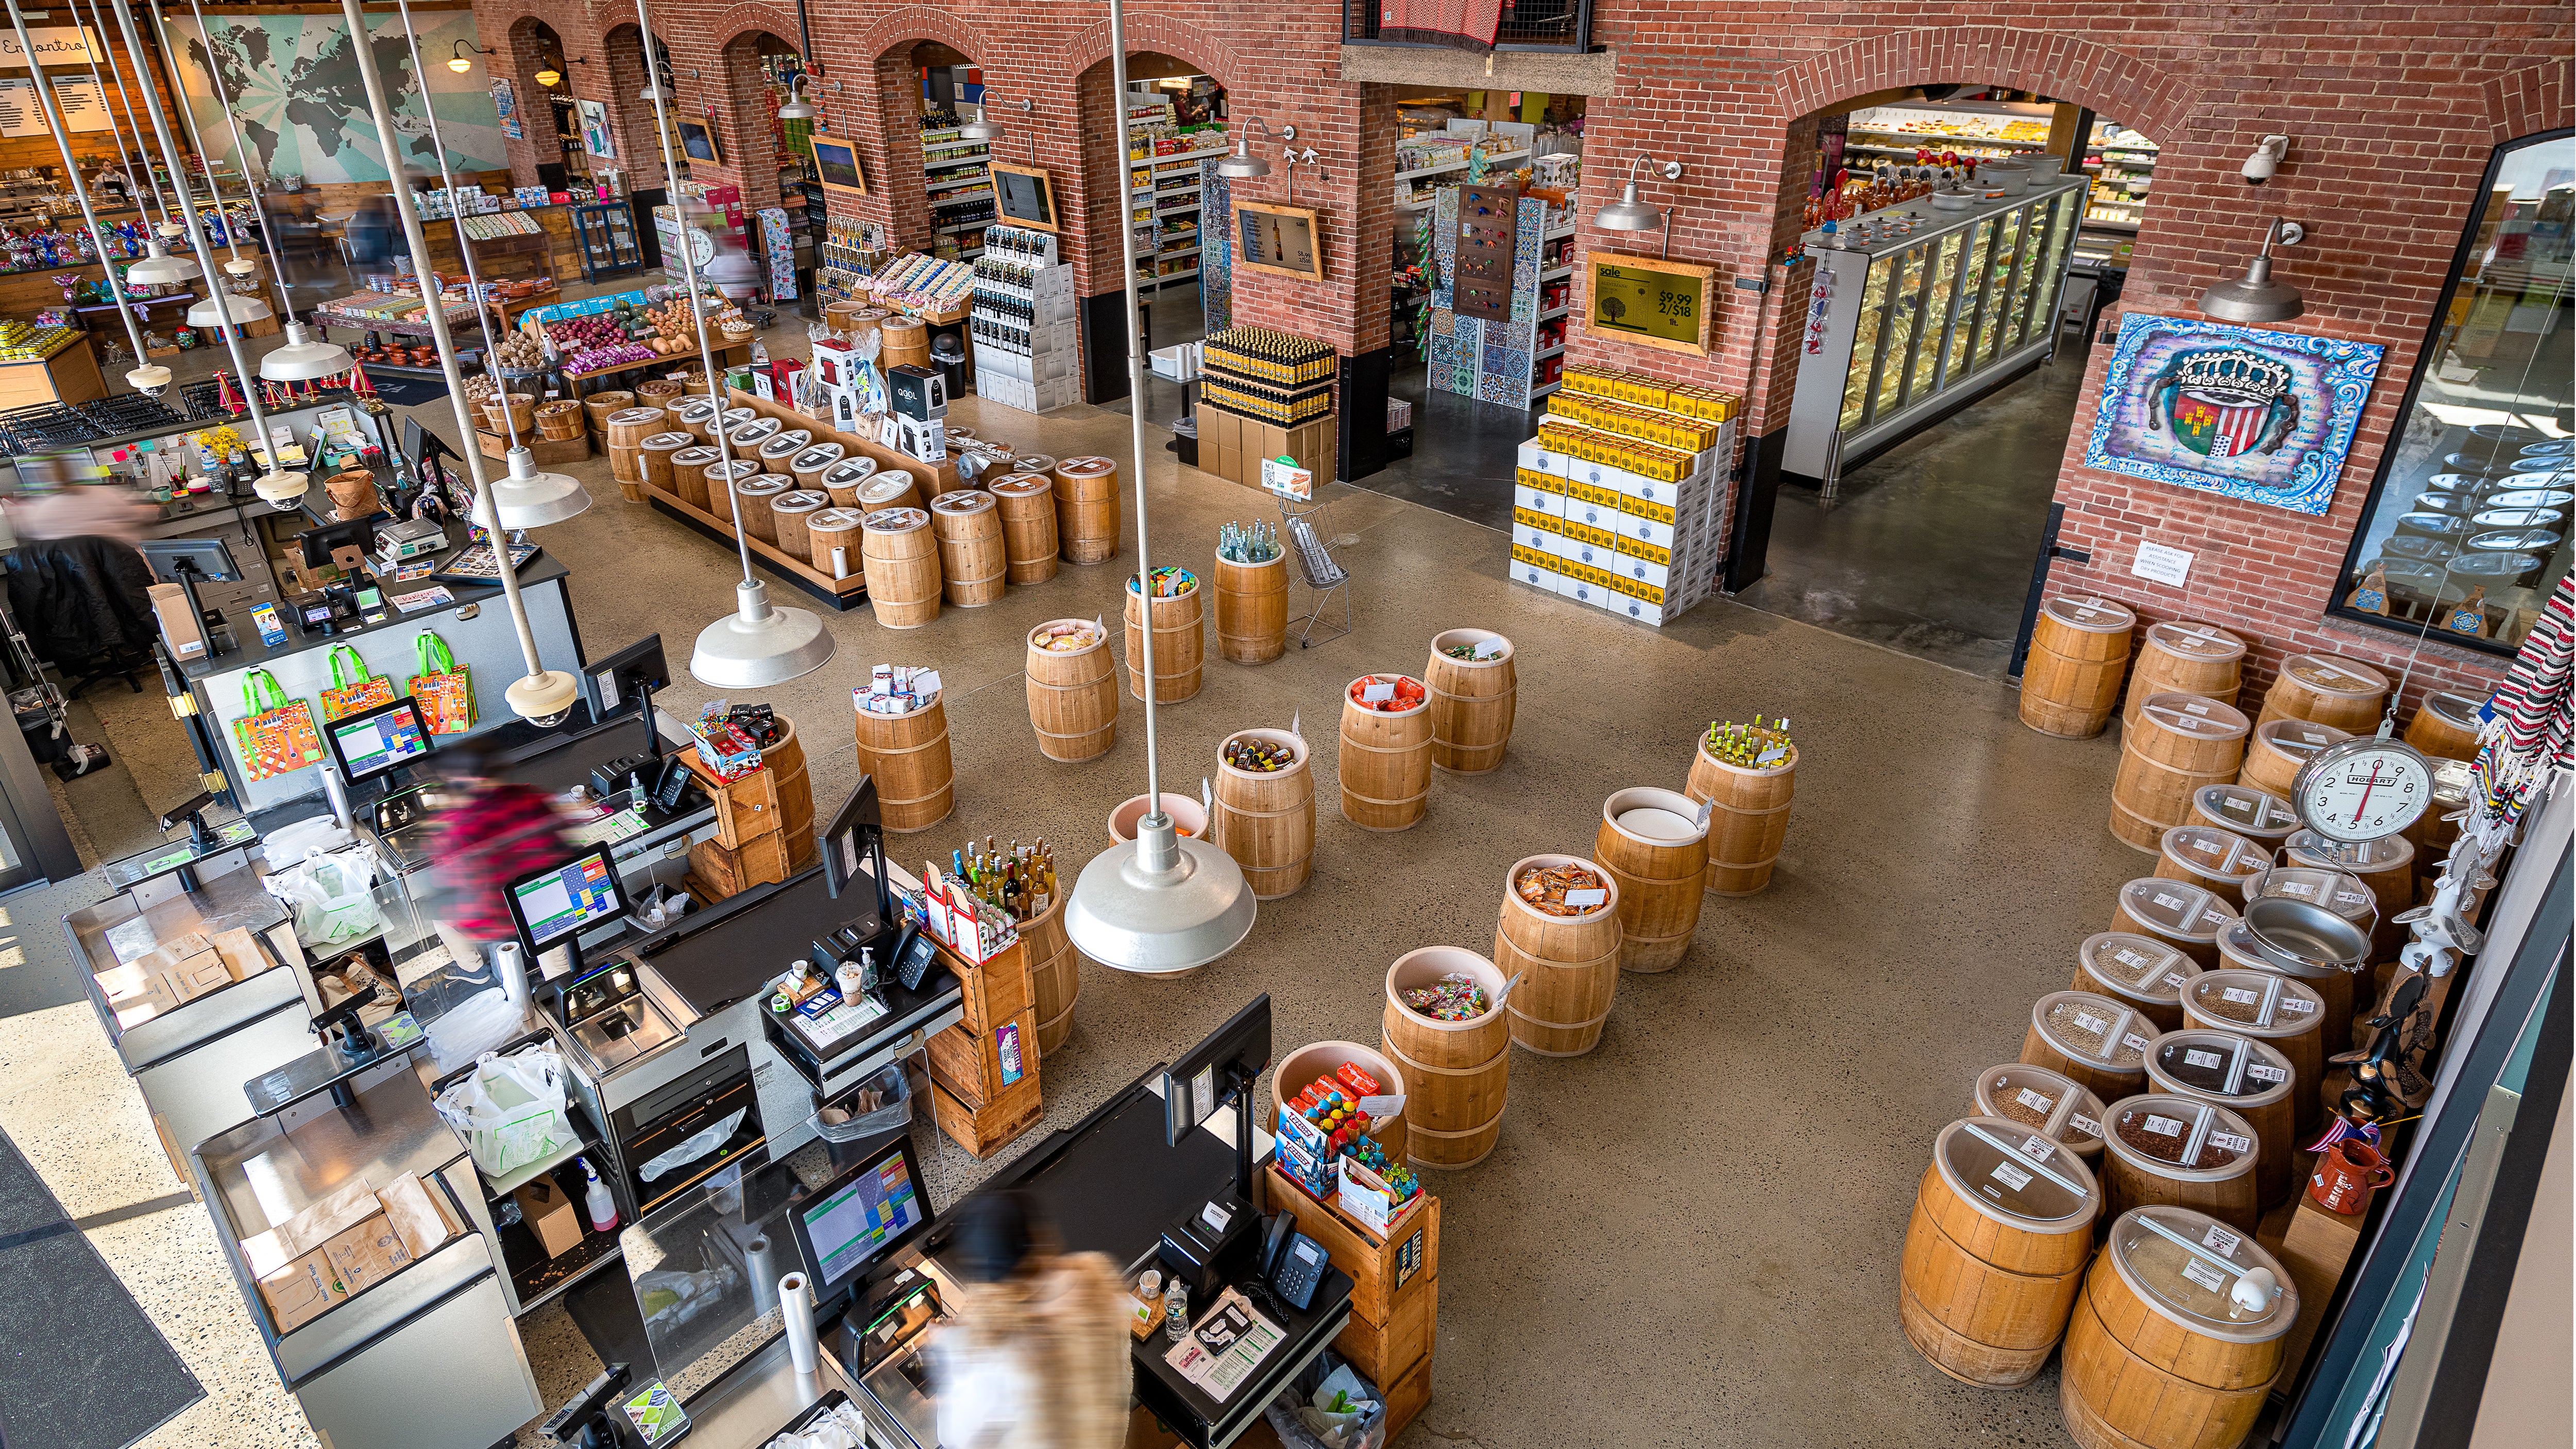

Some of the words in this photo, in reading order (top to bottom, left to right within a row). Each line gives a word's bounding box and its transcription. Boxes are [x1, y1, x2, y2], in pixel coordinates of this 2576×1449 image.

[3, 38, 87, 54] Enontro
[1600, 265, 1620, 277] sale
[1659, 290, 1692, 306] $9.99
[1658, 302, 1691, 317] 2/$18
[898, 389, 917, 400] QOOL
[2115, 419, 2139, 428] Santos
[2148, 554, 2176, 564] ASSISTANCE
[2156, 563, 2180, 573] SCOOPING
[2150, 568, 2176, 579] PRODUCTS
[2349, 763, 2355, 773] 1
[2372, 760, 2383, 770] 0
[2395, 767, 2405, 777] 9
[2324, 777, 2336, 788] 2
[2403, 783, 2414, 793] 8
[2317, 797, 2328, 807] 3
[2396, 802, 2409, 813] 7
[2326, 813, 2337, 823] 4
[2374, 816, 2383, 826] 6
[2348, 820, 2359, 830] 5
[1412, 1229, 1421, 1275] CASCADE
[1183, 1352, 1200, 1368] torresmo
